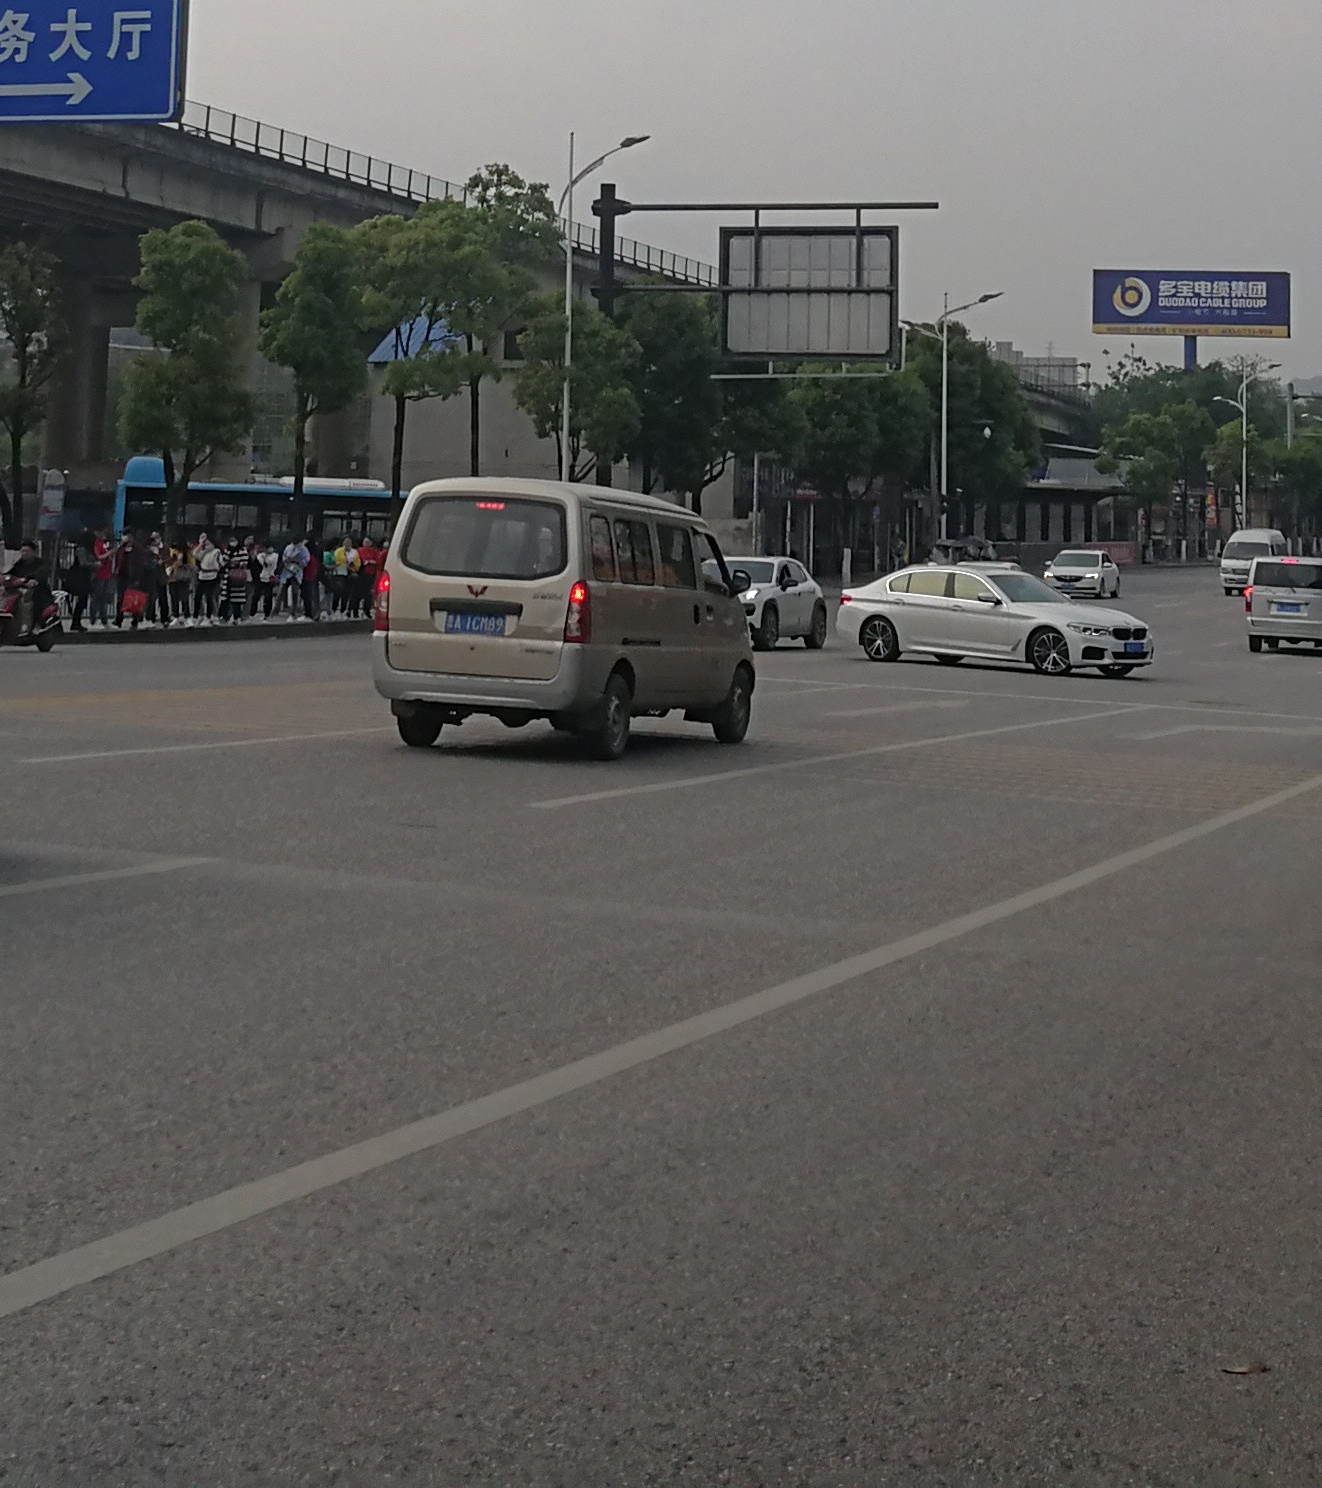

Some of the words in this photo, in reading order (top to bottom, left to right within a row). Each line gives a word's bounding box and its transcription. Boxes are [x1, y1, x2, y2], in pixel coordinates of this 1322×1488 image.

[1158, 280, 1267, 298] 多宝电缆集团
[1231, 299, 1267, 309] GROUP
